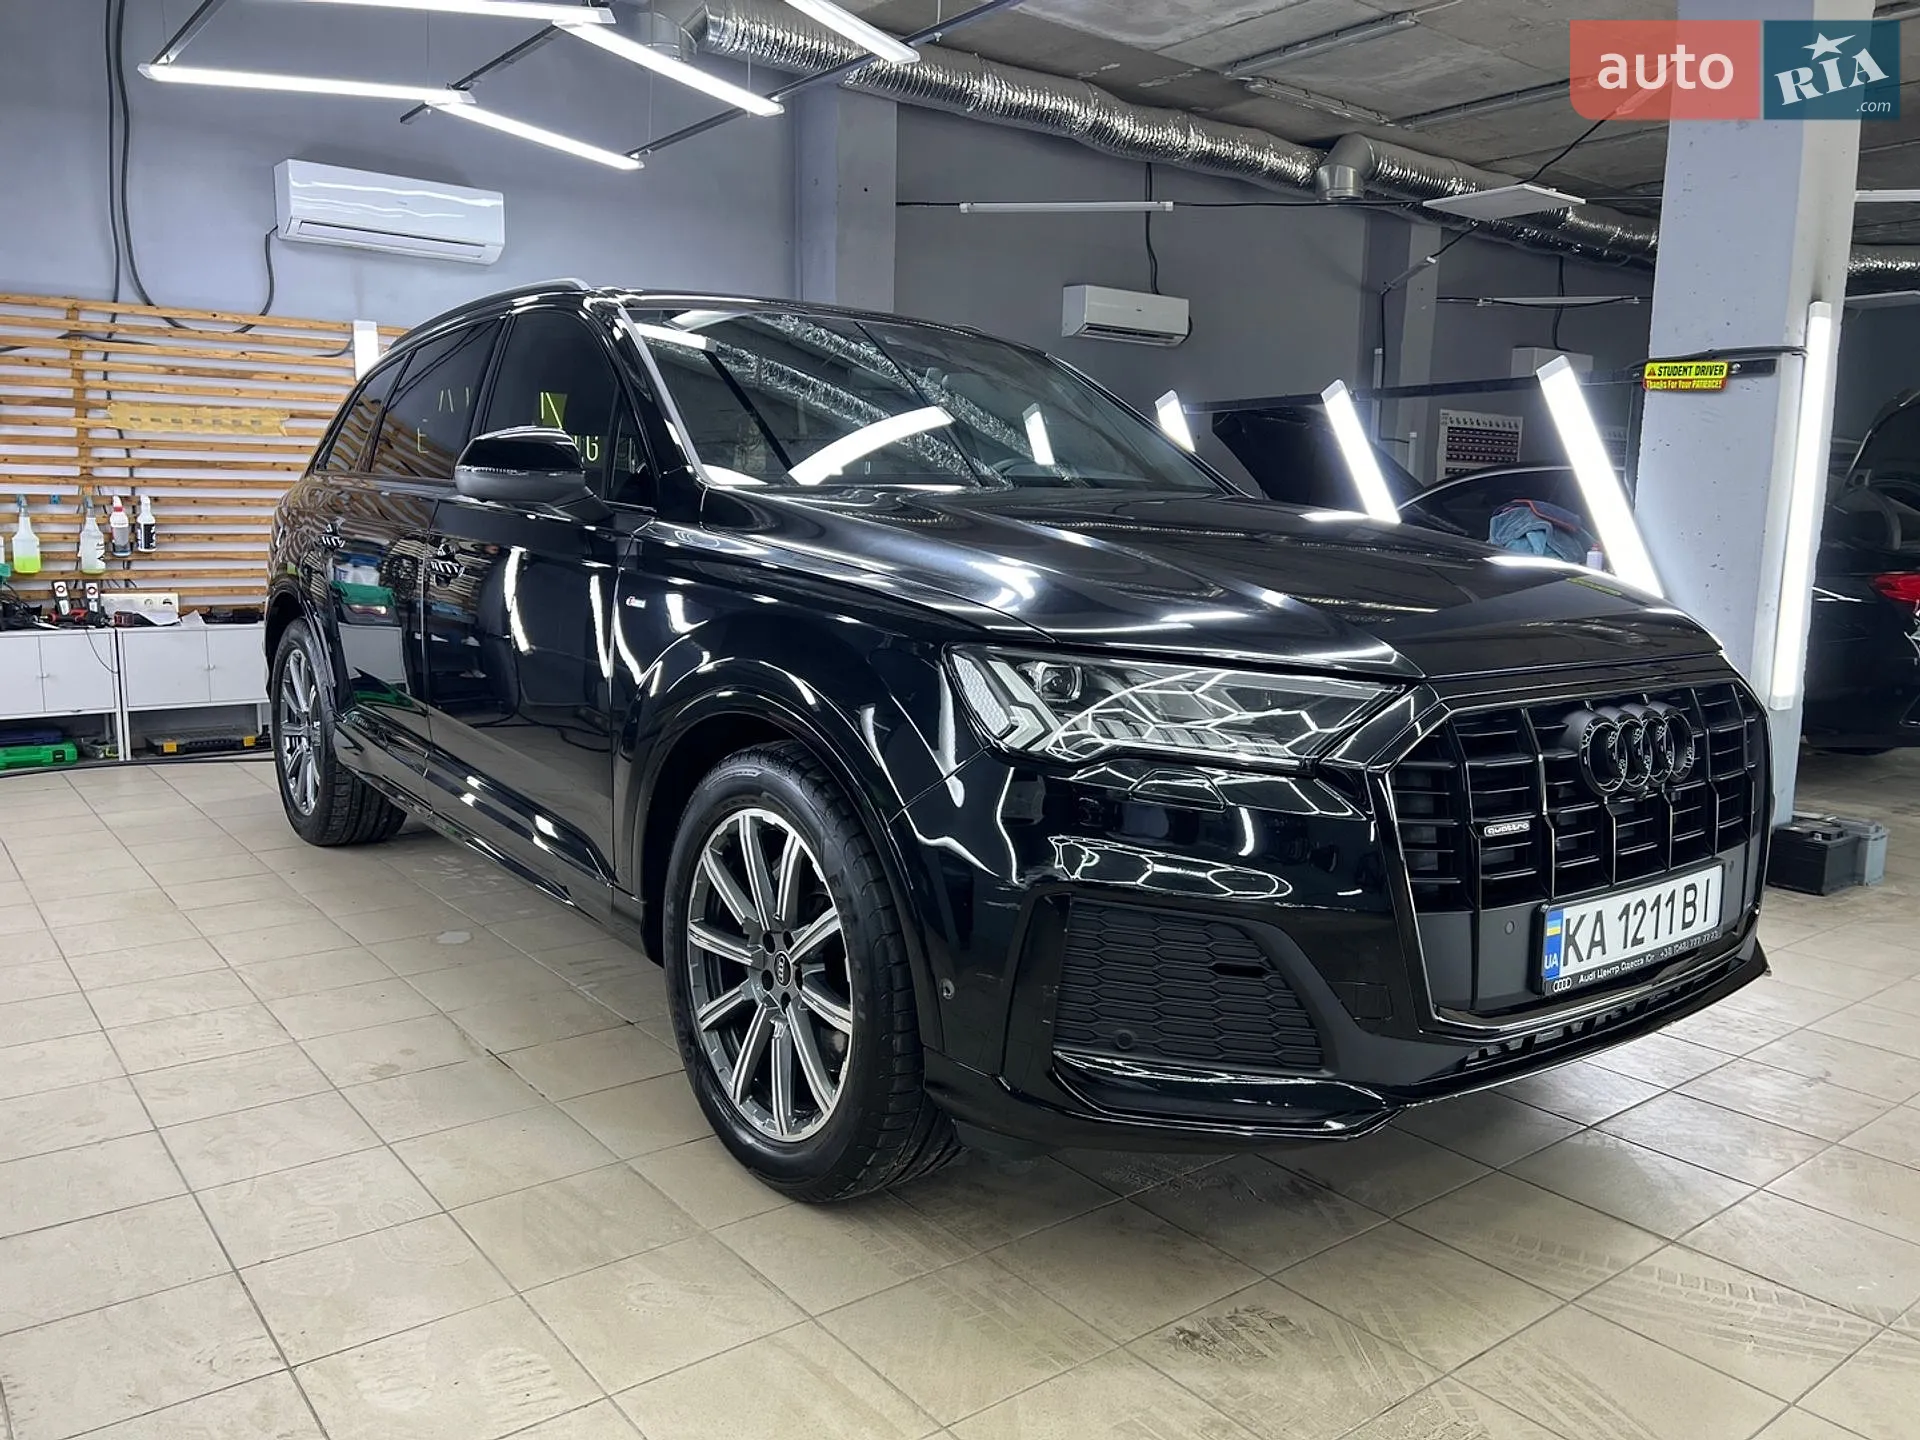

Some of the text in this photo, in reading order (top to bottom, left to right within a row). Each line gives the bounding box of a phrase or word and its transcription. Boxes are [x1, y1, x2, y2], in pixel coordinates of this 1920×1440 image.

[1657, 364, 1725, 377] STUDENT DRIVER
[1562, 909, 1607, 967] KA
[1544, 953, 1559, 970] UA
[1578, 970, 1596, 984] Audi
[1597, 964, 1620, 980] Центр
[1621, 957, 1644, 973] Одесса
